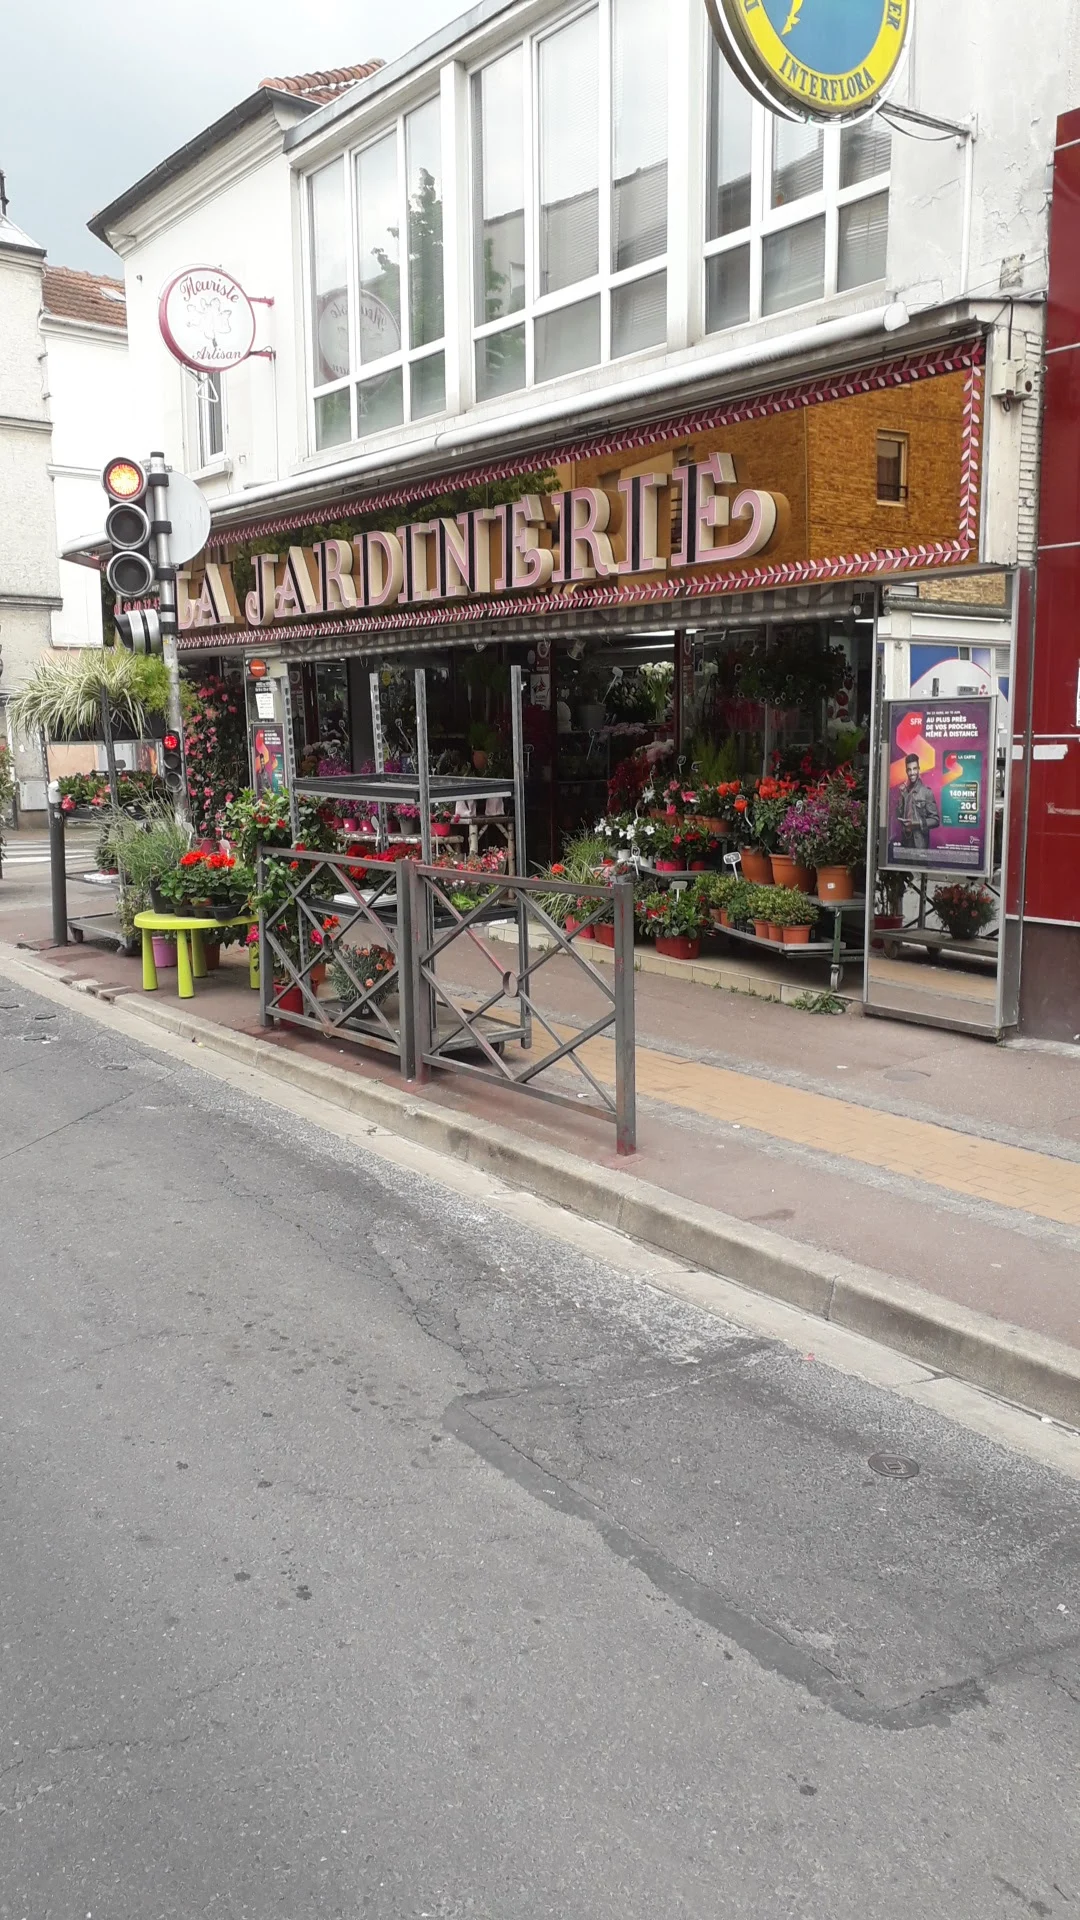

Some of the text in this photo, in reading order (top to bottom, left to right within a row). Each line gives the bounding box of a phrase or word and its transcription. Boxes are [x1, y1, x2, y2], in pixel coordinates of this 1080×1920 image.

[779, 52, 876, 101] INTERFLORA
[179, 276, 240, 303] Fleuriste
[192, 346, 241, 360] Artisan
[175, 452, 777, 630] LA JARDINERIE
[910, 717, 923, 726] SFR
[925, 730, 943, 738] MÊME
